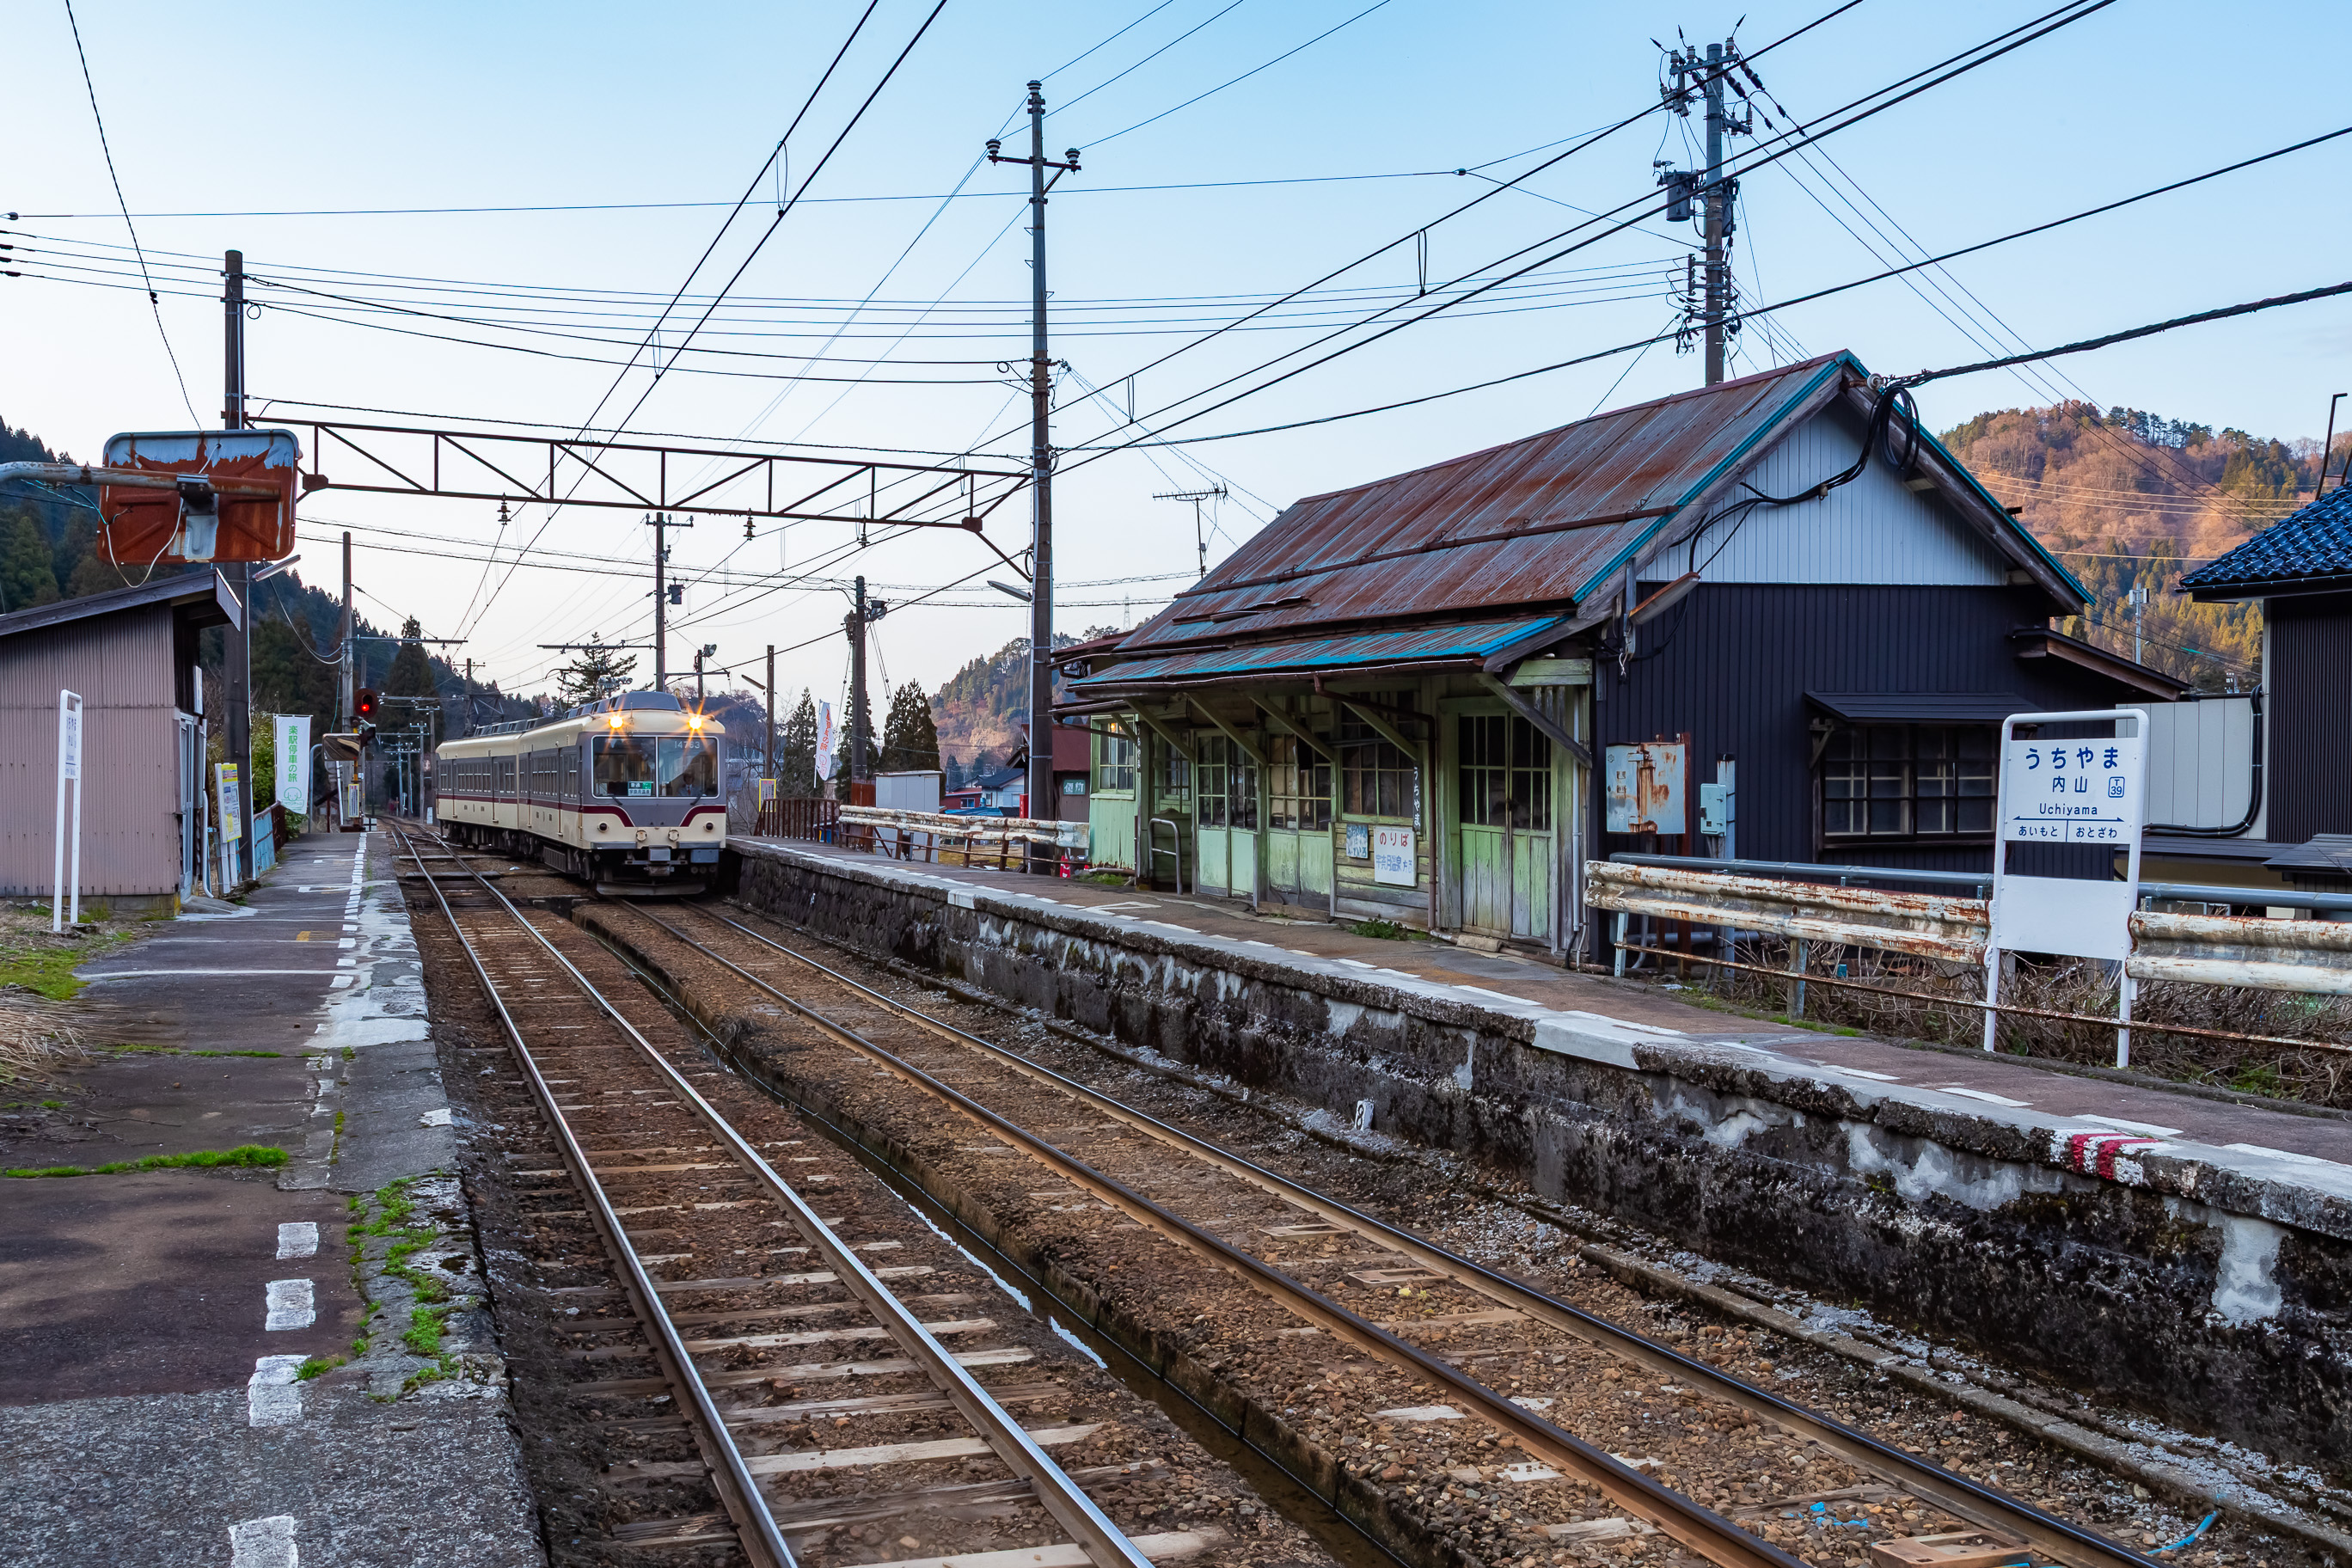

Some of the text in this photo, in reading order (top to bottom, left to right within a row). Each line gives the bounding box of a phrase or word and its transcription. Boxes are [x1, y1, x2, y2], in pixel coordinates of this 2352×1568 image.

[288, 726, 297, 782] 楽駅停車の旅
[2025, 746, 2118, 769] うちやま
[2052, 775, 2087, 793] 内山
[2110, 786, 2122, 795] 39
[2039, 803, 2098, 816] Uchiyama
[2018, 825, 2058, 836] あいもと
[2076, 826, 2117, 838] おとざわ
[1379, 832, 1409, 847] のりば
[1356, 1104, 1364, 1130] 8
